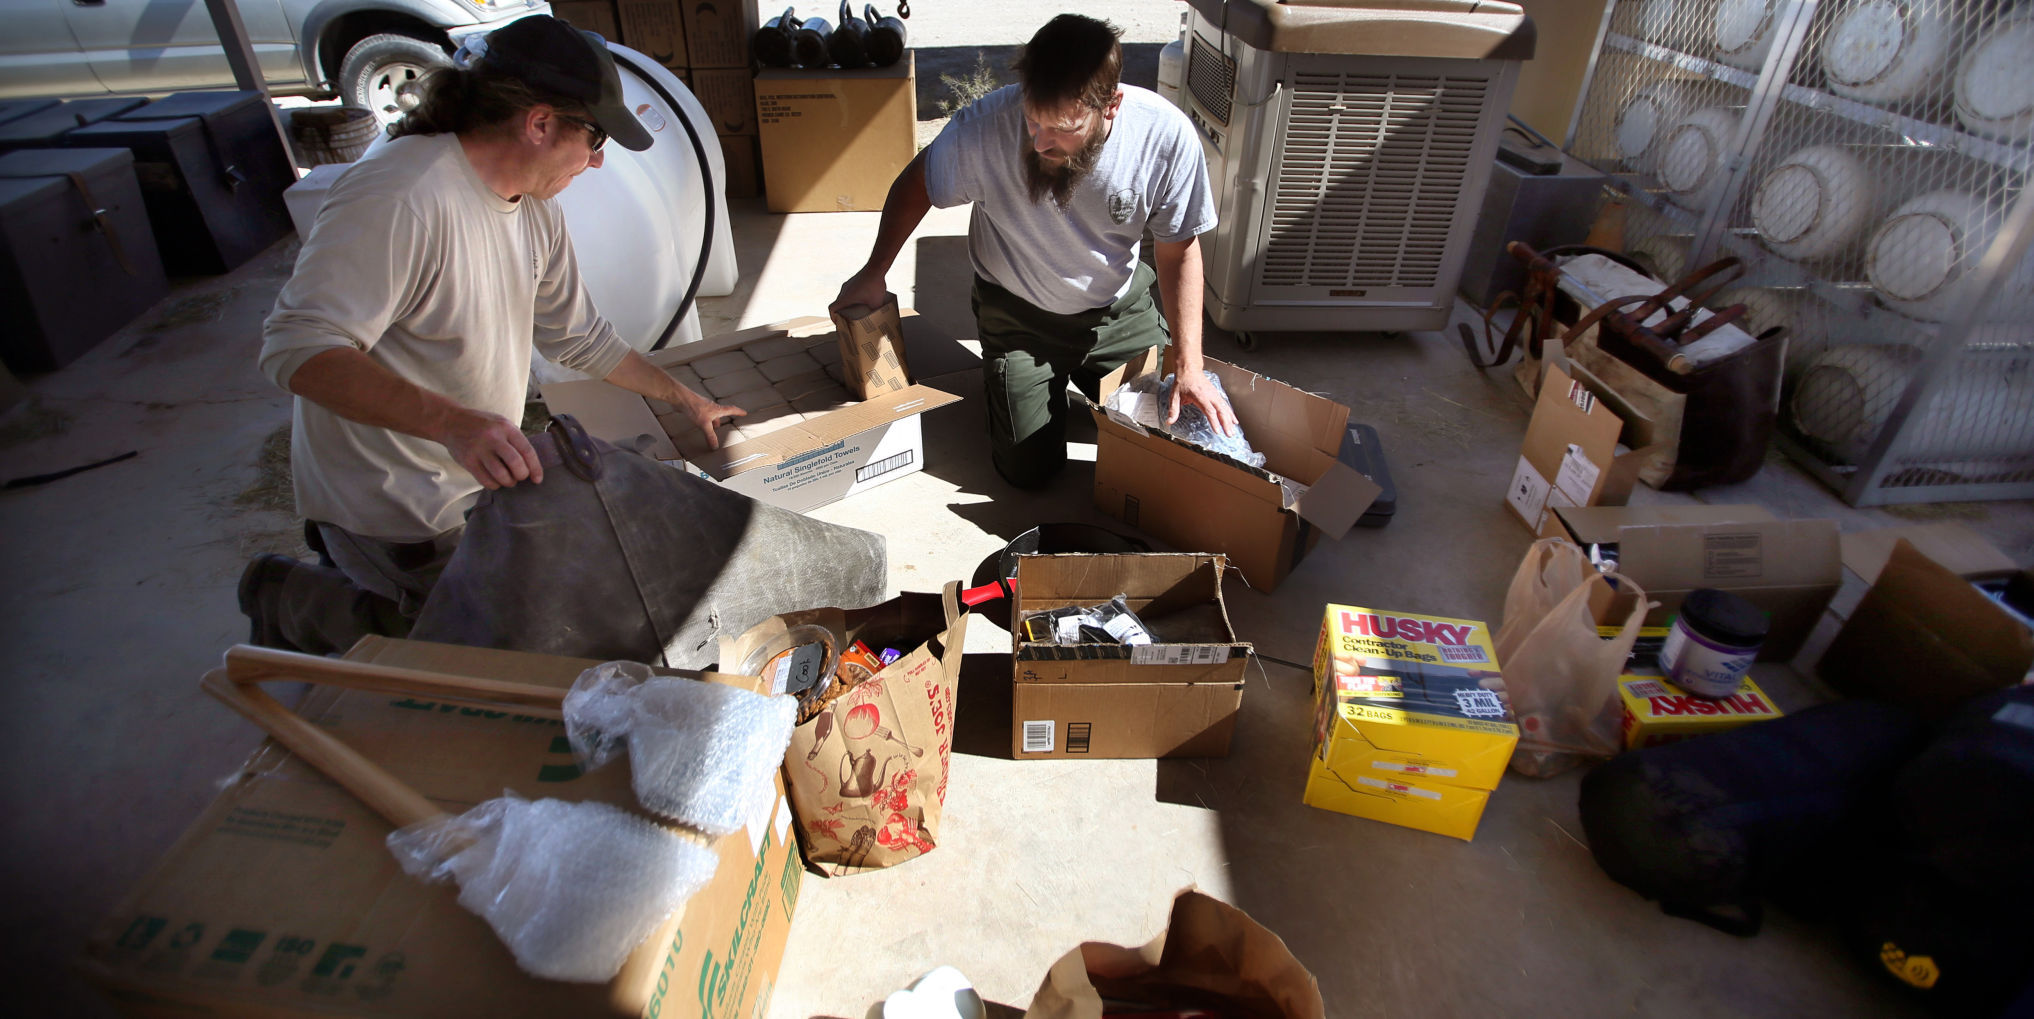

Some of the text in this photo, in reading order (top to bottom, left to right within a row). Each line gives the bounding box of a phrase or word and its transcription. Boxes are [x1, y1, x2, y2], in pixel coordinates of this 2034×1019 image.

[763, 469, 793, 484] Natural
[795, 455, 833, 473] Singlefold
[834, 446, 860, 459] Towels
[1341, 611, 1473, 646] HUSKY
[1342, 636, 1409, 650] Contractor
[1404, 650, 1438, 662] Bags
[1346, 705, 1393, 721] 32 BAGS
[1464, 698, 1497, 709] 3 MIL
[1649, 693, 1773, 716] HUSKY
[927, 683, 949, 807] TRADER JOE'S
[717, 825, 771, 1008] SKILCRAFT
